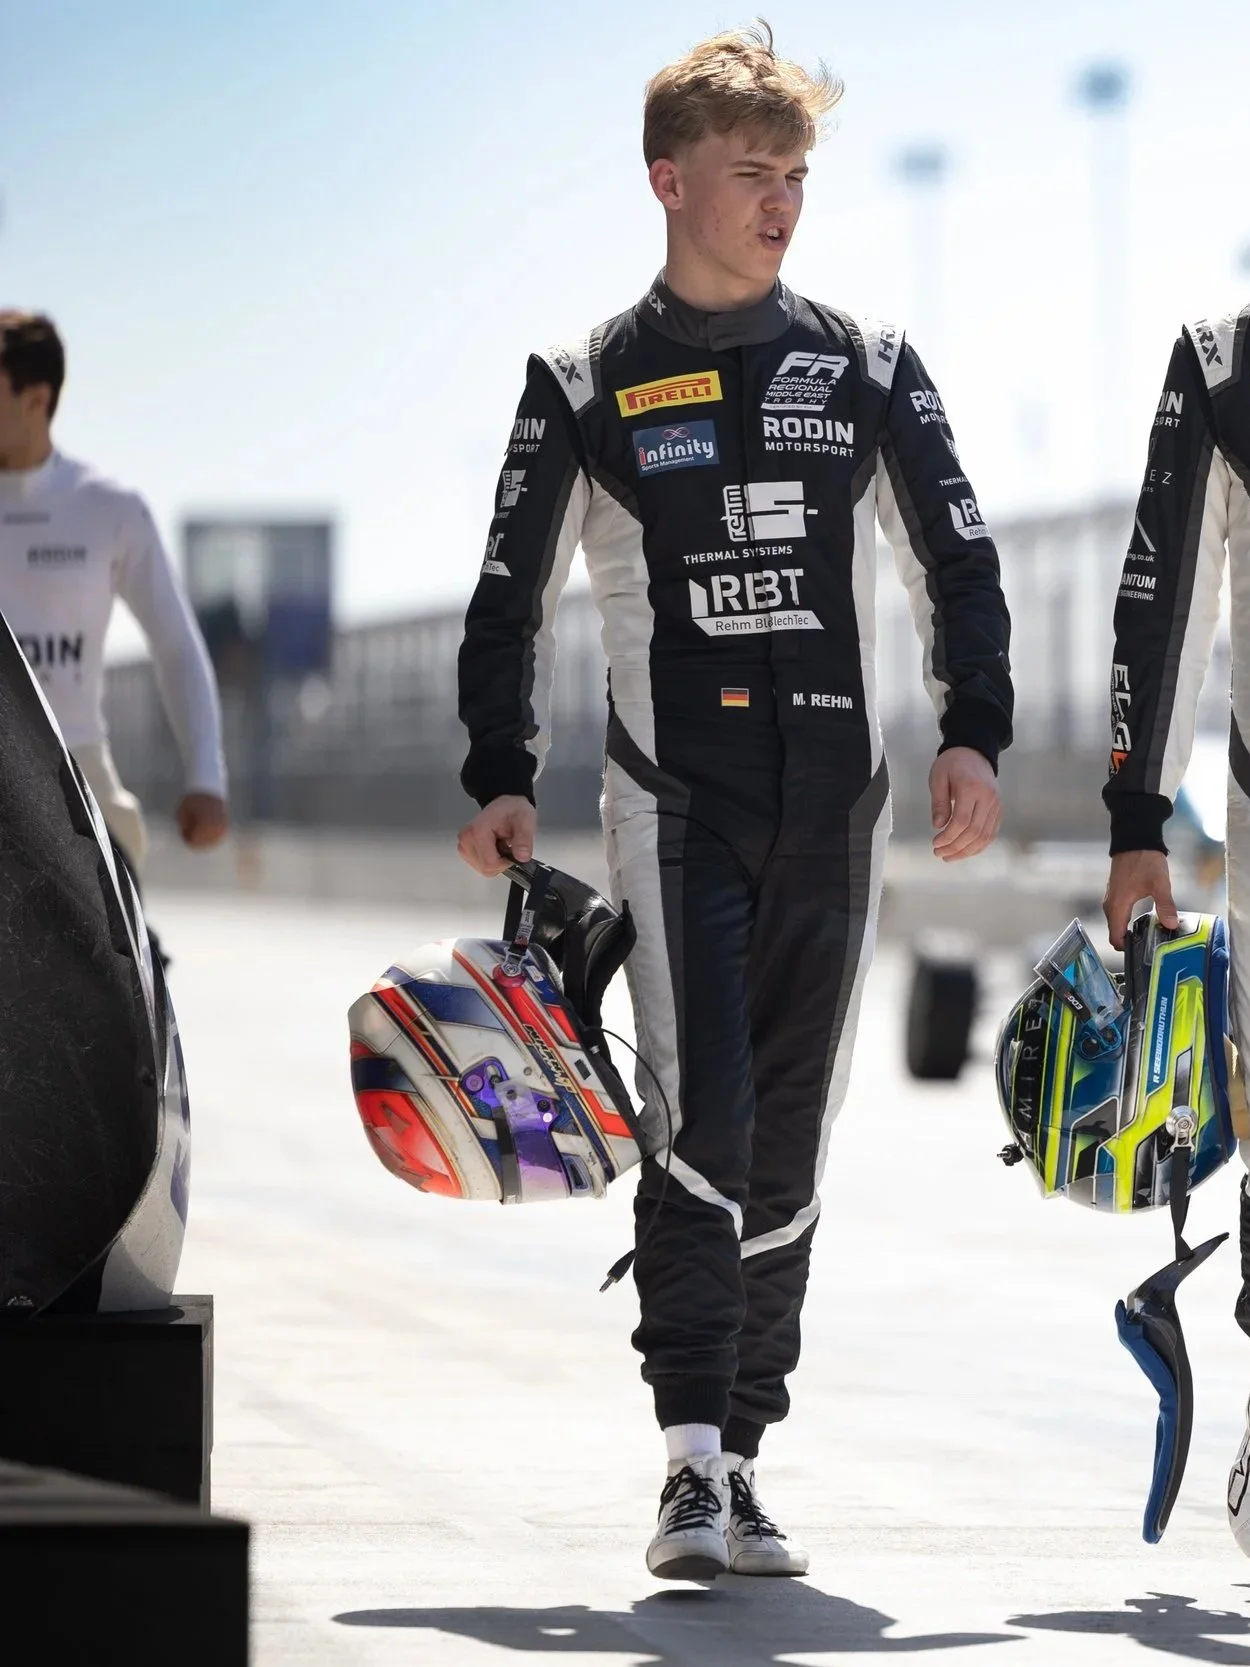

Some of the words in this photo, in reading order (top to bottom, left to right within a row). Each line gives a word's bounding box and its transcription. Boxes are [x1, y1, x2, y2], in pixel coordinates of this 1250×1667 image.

[776, 351, 850, 379] FR
[768, 384, 832, 393] REGIONAL
[771, 376, 837, 385] FORMULA
[625, 377, 712, 410] PIRELLI
[803, 391, 831, 399] EAST
[763, 416, 854, 445] RODIN
[638, 439, 715, 466] infinity
[765, 441, 854, 458] MOTORSPORT
[641, 461, 660, 471] Sports
[660, 456, 695, 466] Management
[683, 549, 739, 565] THERMAL
[742, 545, 793, 558] SYSTEMS
[710, 568, 804, 613] RBT
[715, 620, 751, 632] Rehm
[792, 693, 806, 706] M.
[811, 693, 853, 709] REHM
[1153, 1074, 1161, 1084] R
